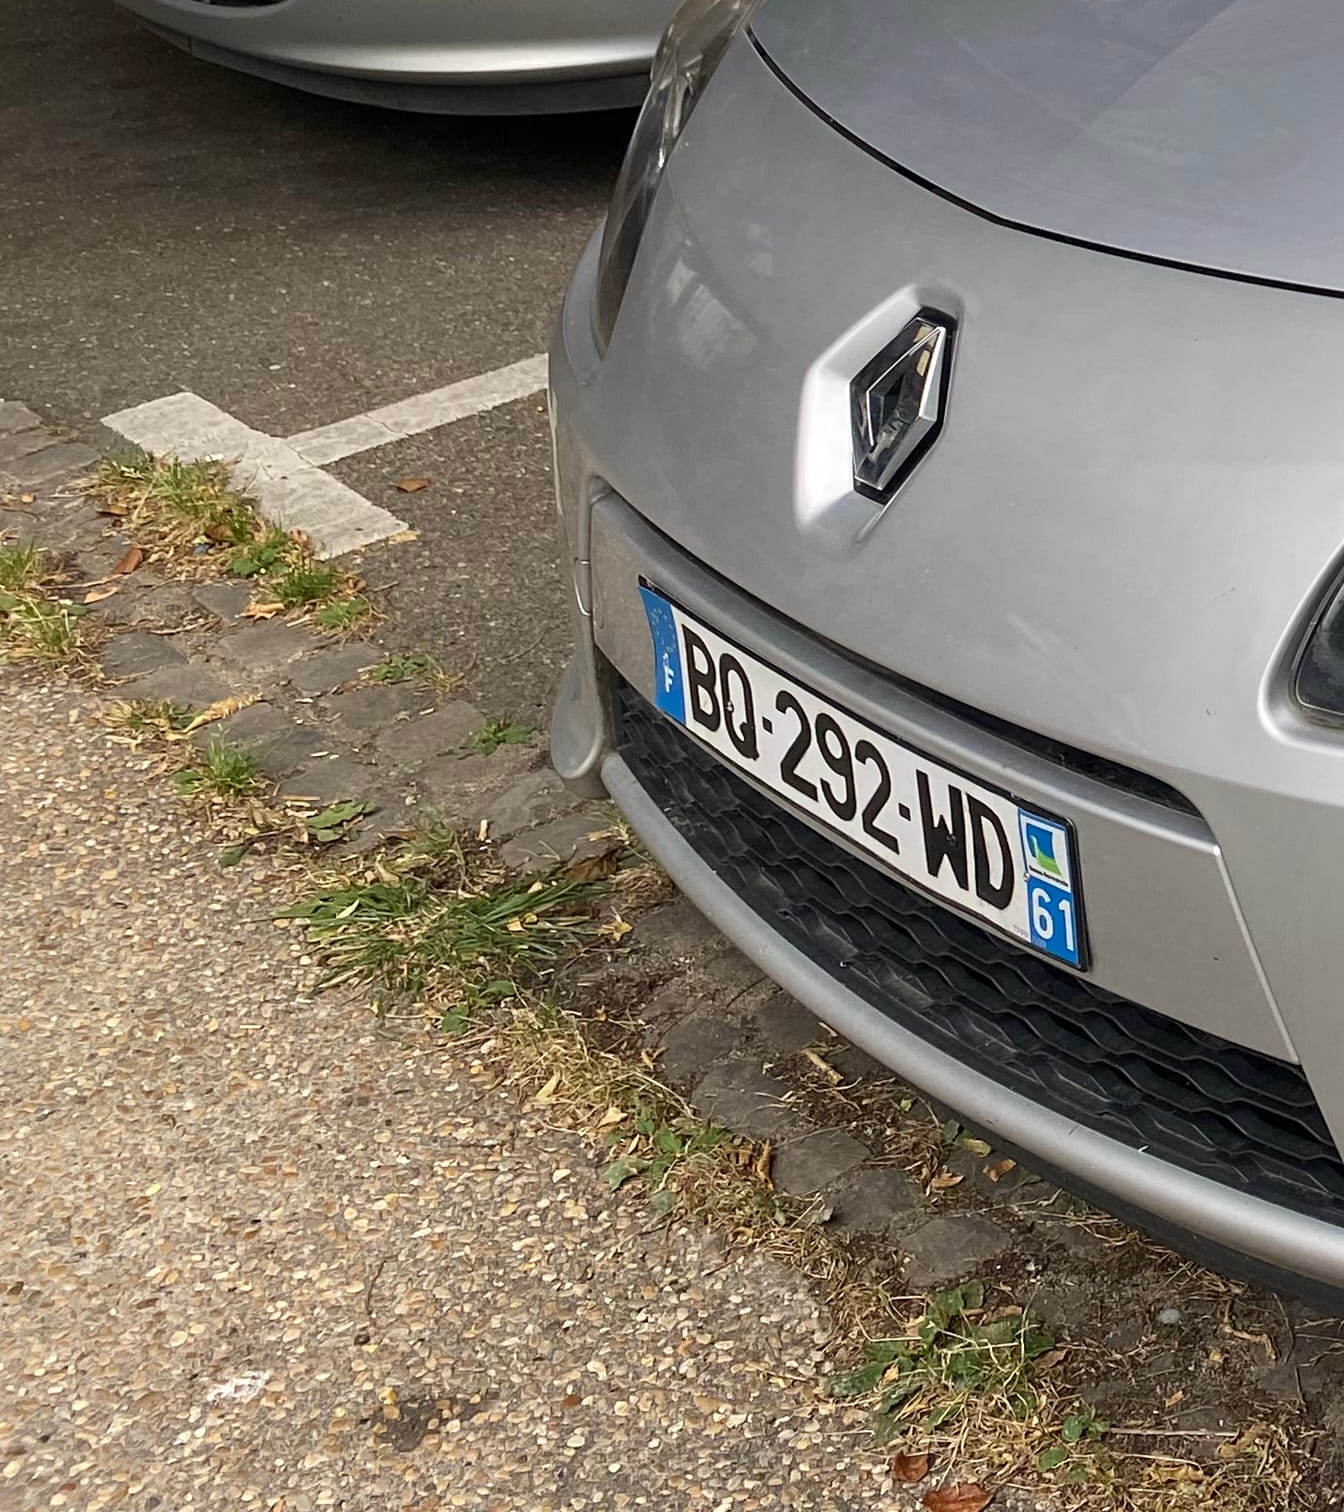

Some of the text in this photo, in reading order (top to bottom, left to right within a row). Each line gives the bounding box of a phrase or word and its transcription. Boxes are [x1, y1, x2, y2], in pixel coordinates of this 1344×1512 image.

[663, 622, 1075, 952] F BQ-292-WD 61
